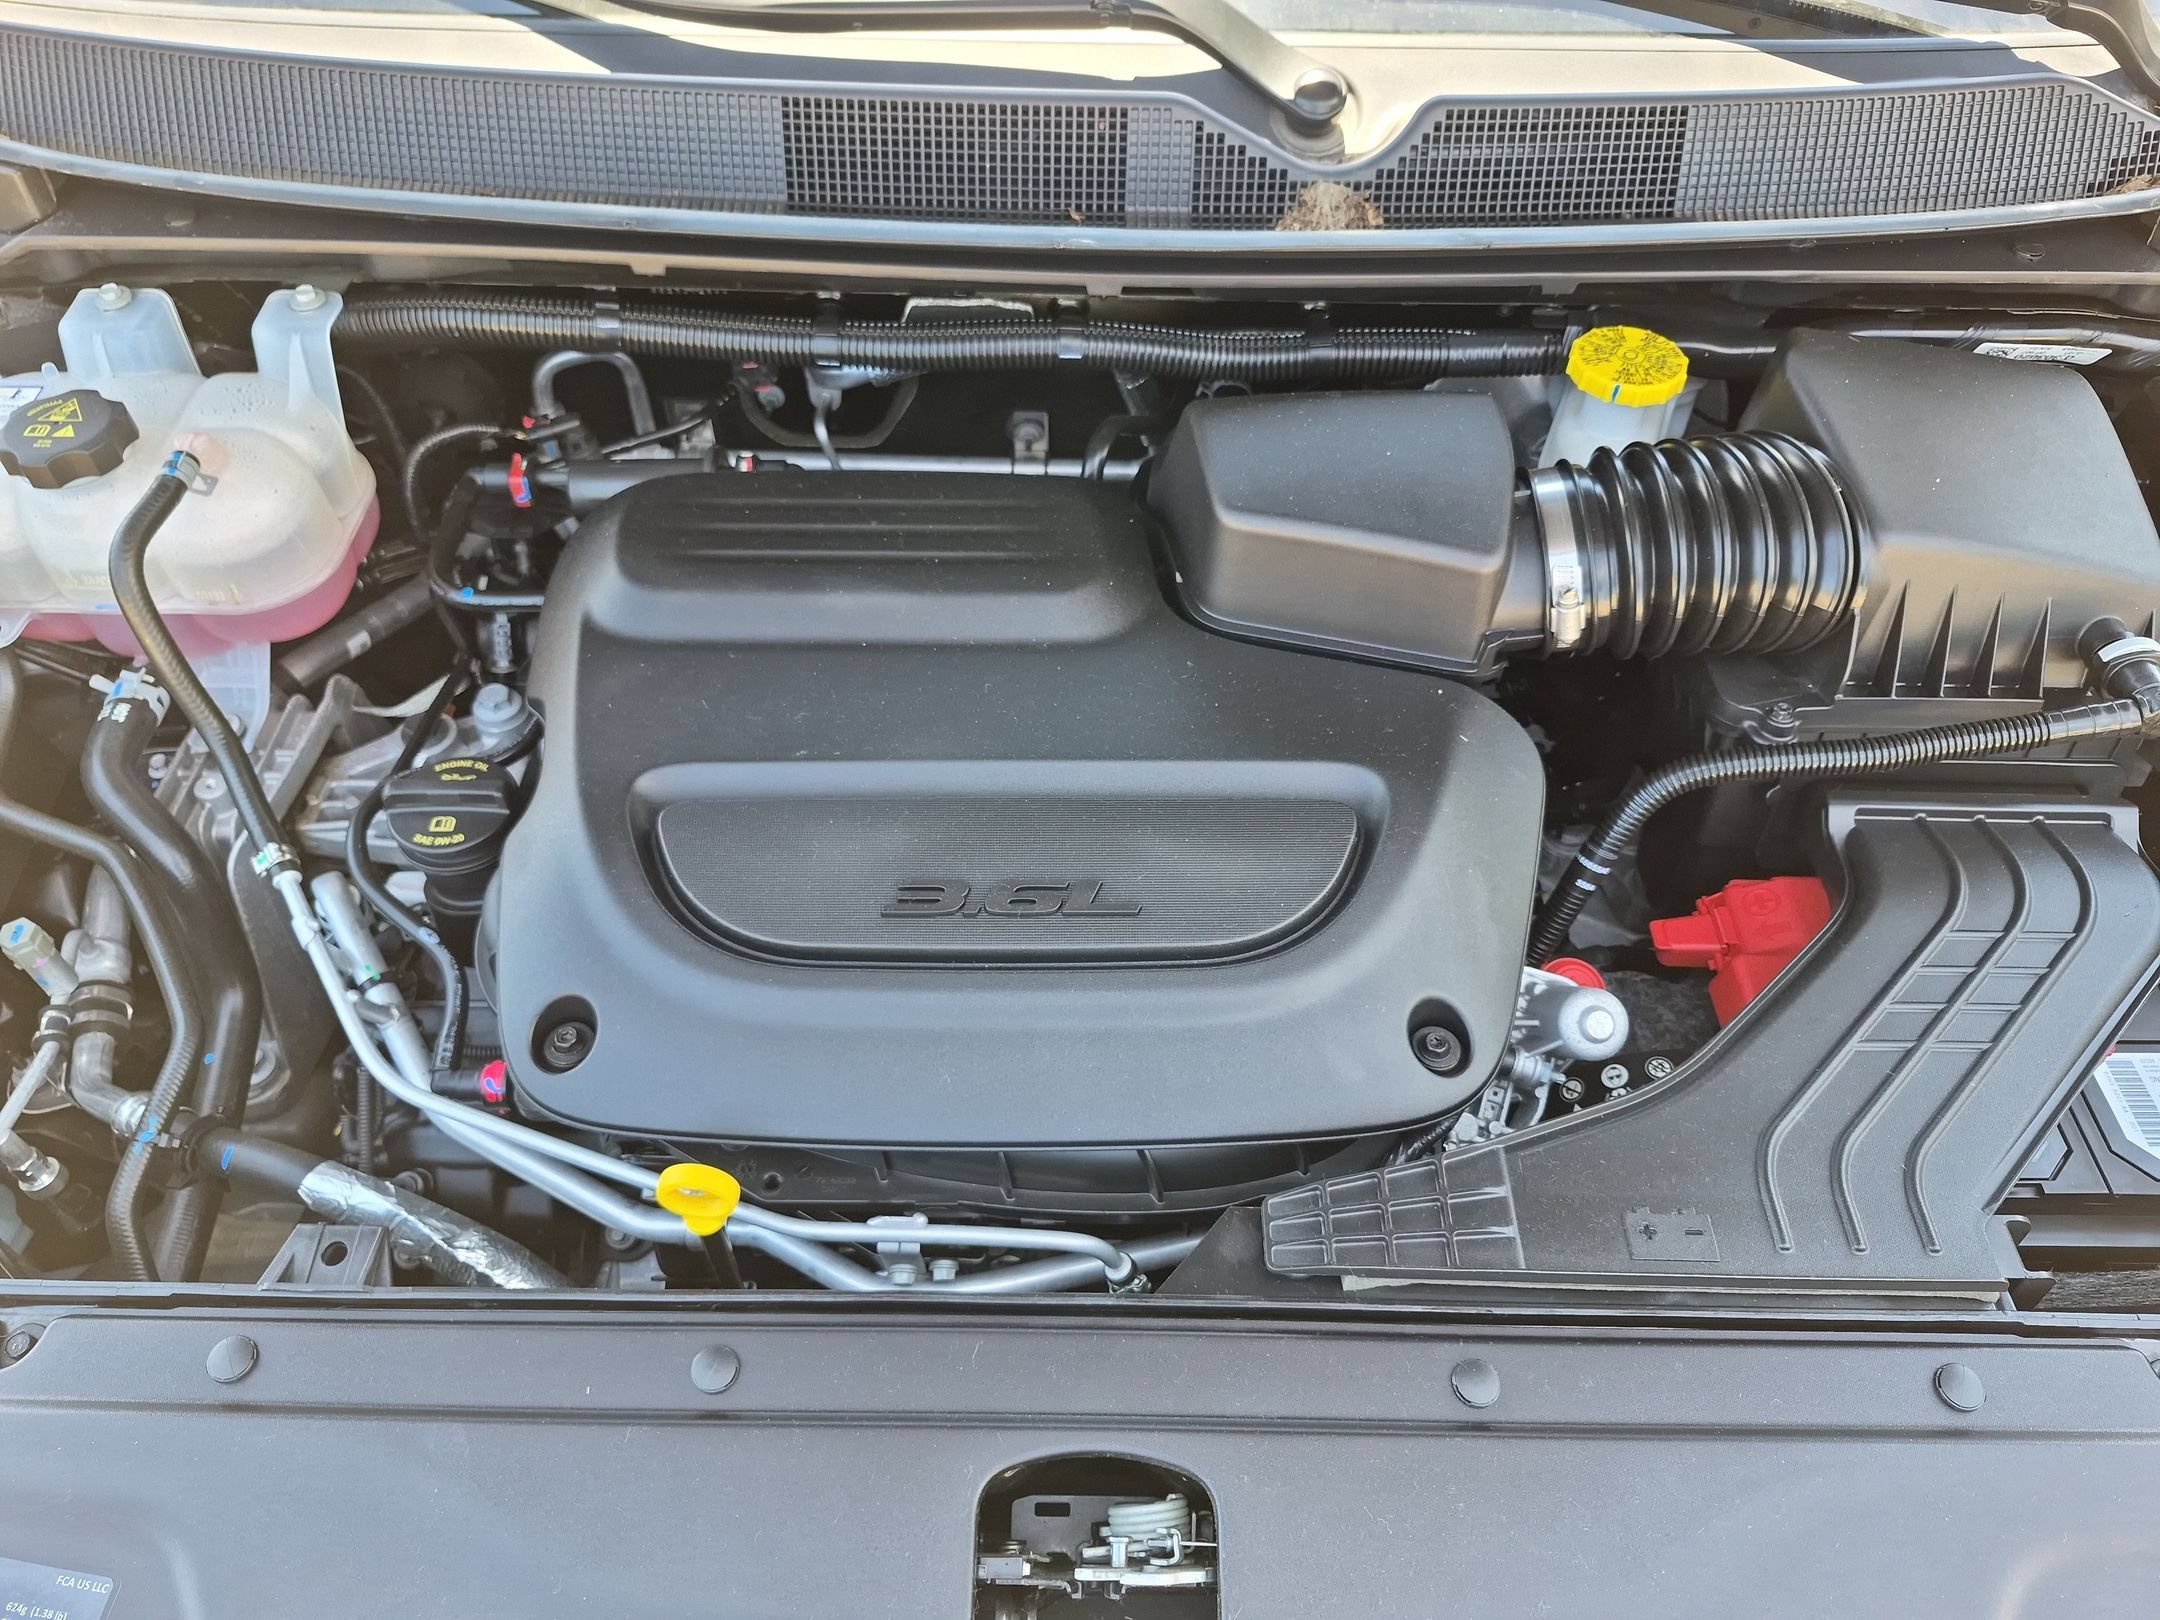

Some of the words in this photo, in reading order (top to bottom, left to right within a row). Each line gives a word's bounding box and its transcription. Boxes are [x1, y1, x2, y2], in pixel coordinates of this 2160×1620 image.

[434, 760, 474, 772] ENGINE
[475, 760, 489, 772] OIL
[412, 833, 433, 846] SAE
[434, 833, 465, 846] 0W-20
[881, 878, 1143, 918] 3.6L
[56, 1575, 75, 1589] FCA
[76, 1579, 92, 1590] US
[91, 1582, 110, 1594] LLC
[5, 1601, 28, 1616] 624g
[30, 1606, 54, 1620] (1.38
